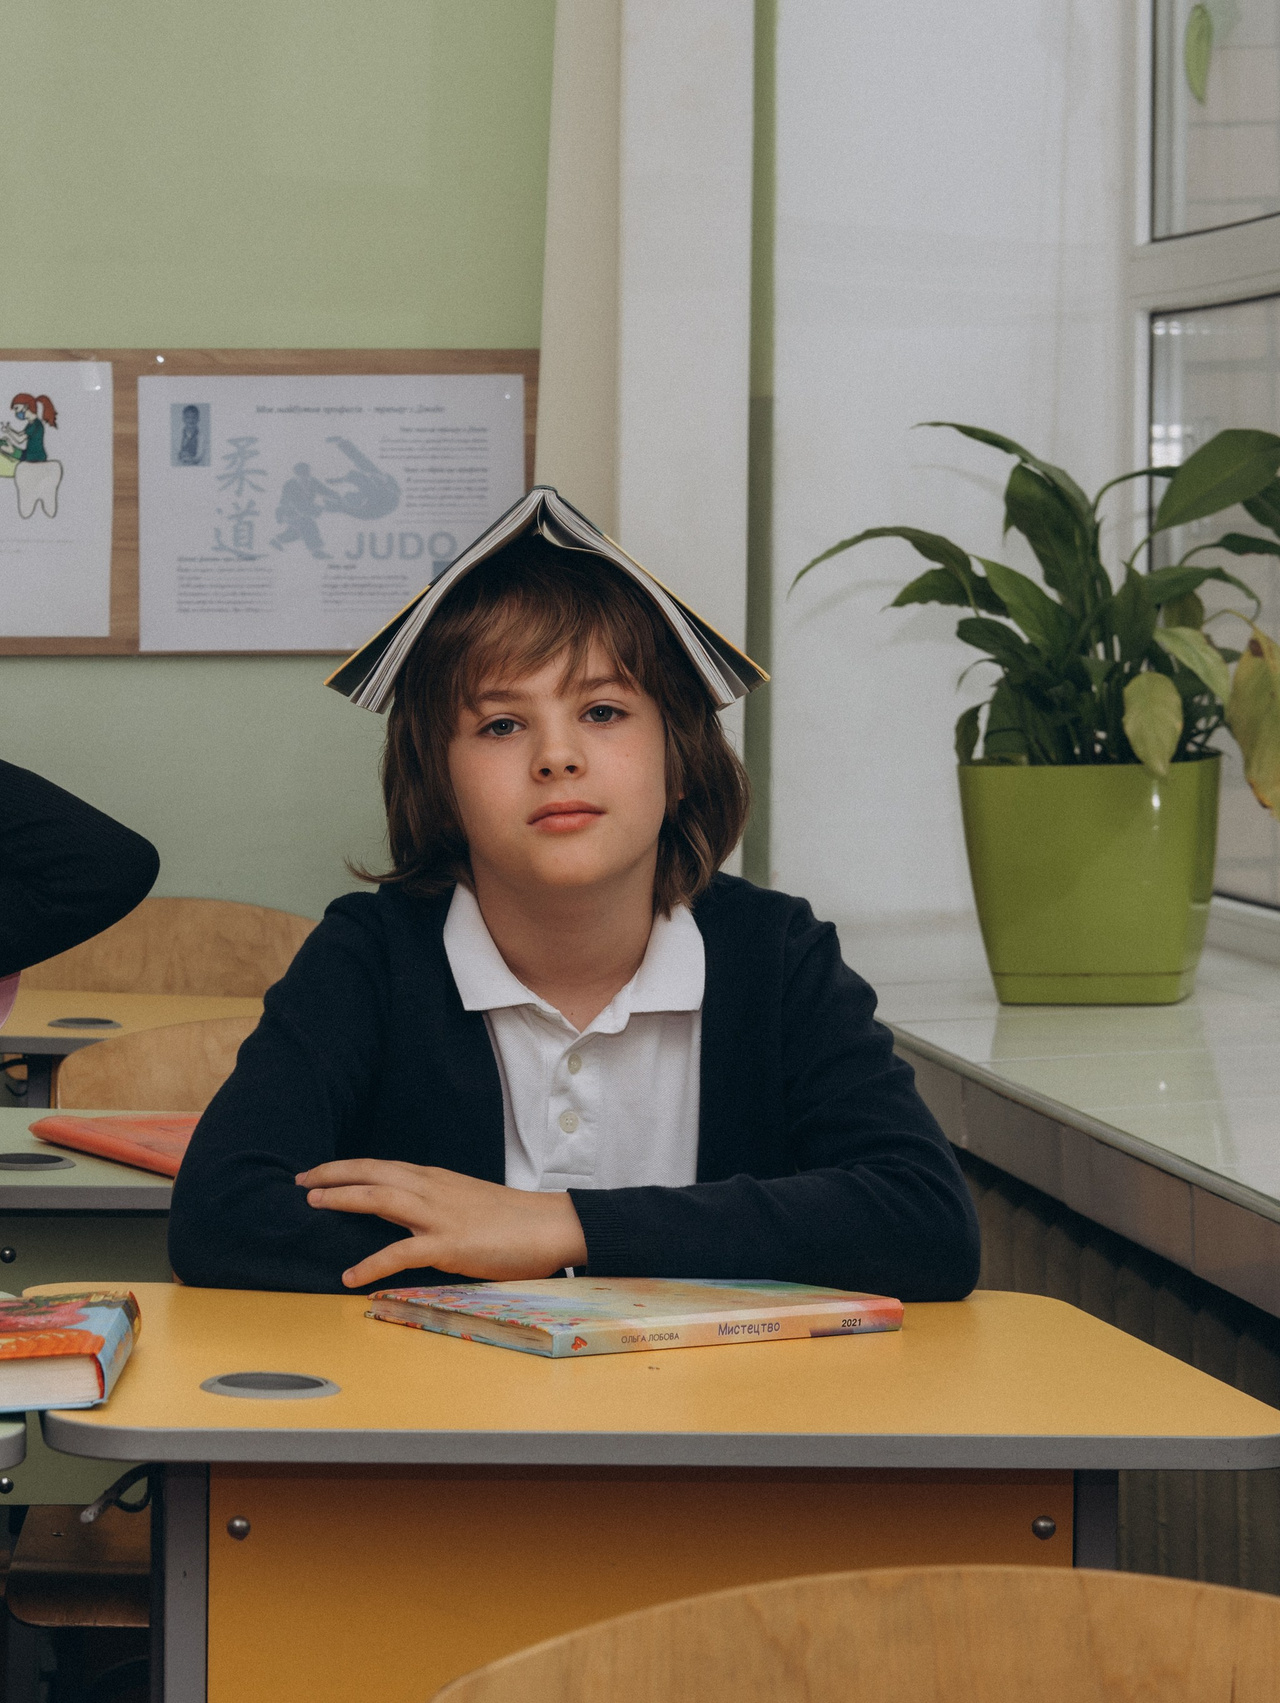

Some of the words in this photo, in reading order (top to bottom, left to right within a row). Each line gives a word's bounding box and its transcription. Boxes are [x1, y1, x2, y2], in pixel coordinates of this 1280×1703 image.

[345, 531, 458, 560] JUDO
[718, 1321, 781, 1336] Мистецтво
[841, 1318, 862, 1328] 2021
[621, 1335, 647, 1344] ОЛЬГА
[648, 1332, 680, 1342] ЛОБОВА
